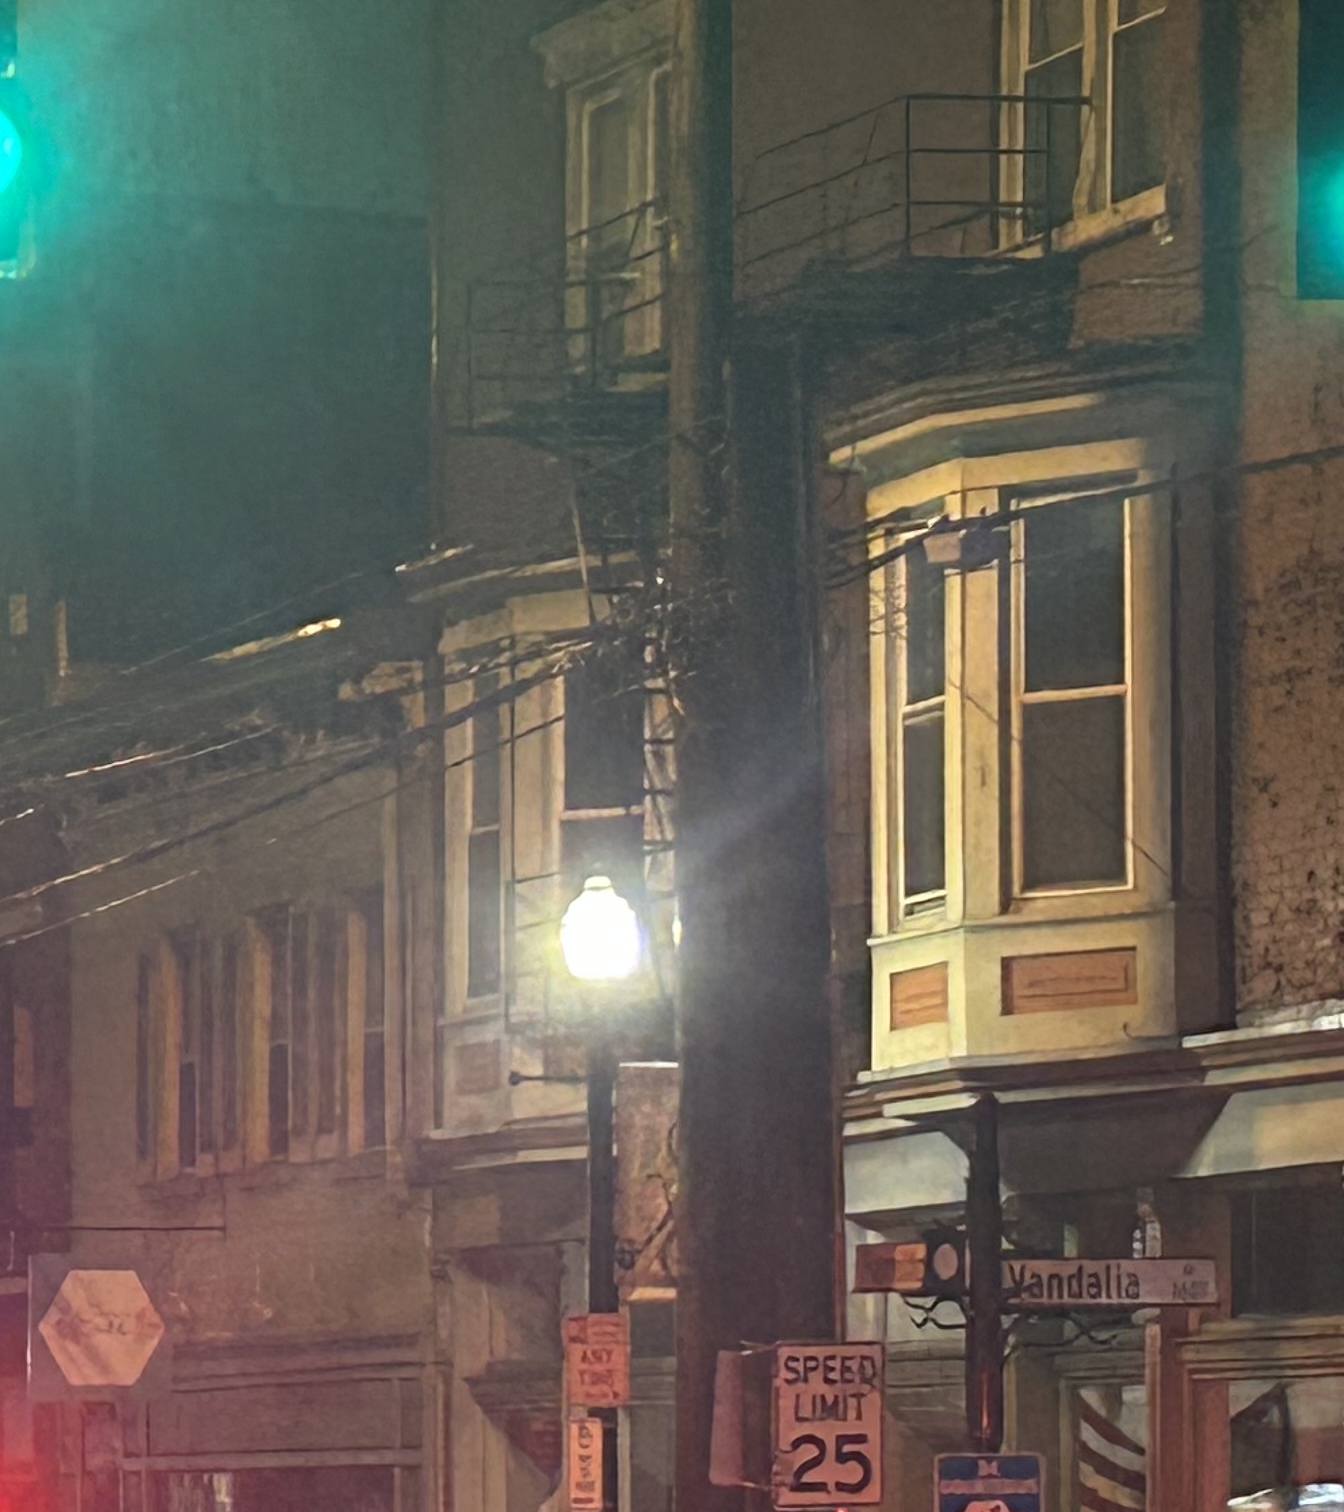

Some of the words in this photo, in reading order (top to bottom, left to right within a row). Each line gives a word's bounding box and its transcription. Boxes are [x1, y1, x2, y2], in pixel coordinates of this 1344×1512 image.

[1008, 1263, 1141, 1300] Vandalia
[783, 1355, 877, 1386] SPEED
[794, 1392, 866, 1422] LIMIT
[789, 1433, 873, 1494] 25
